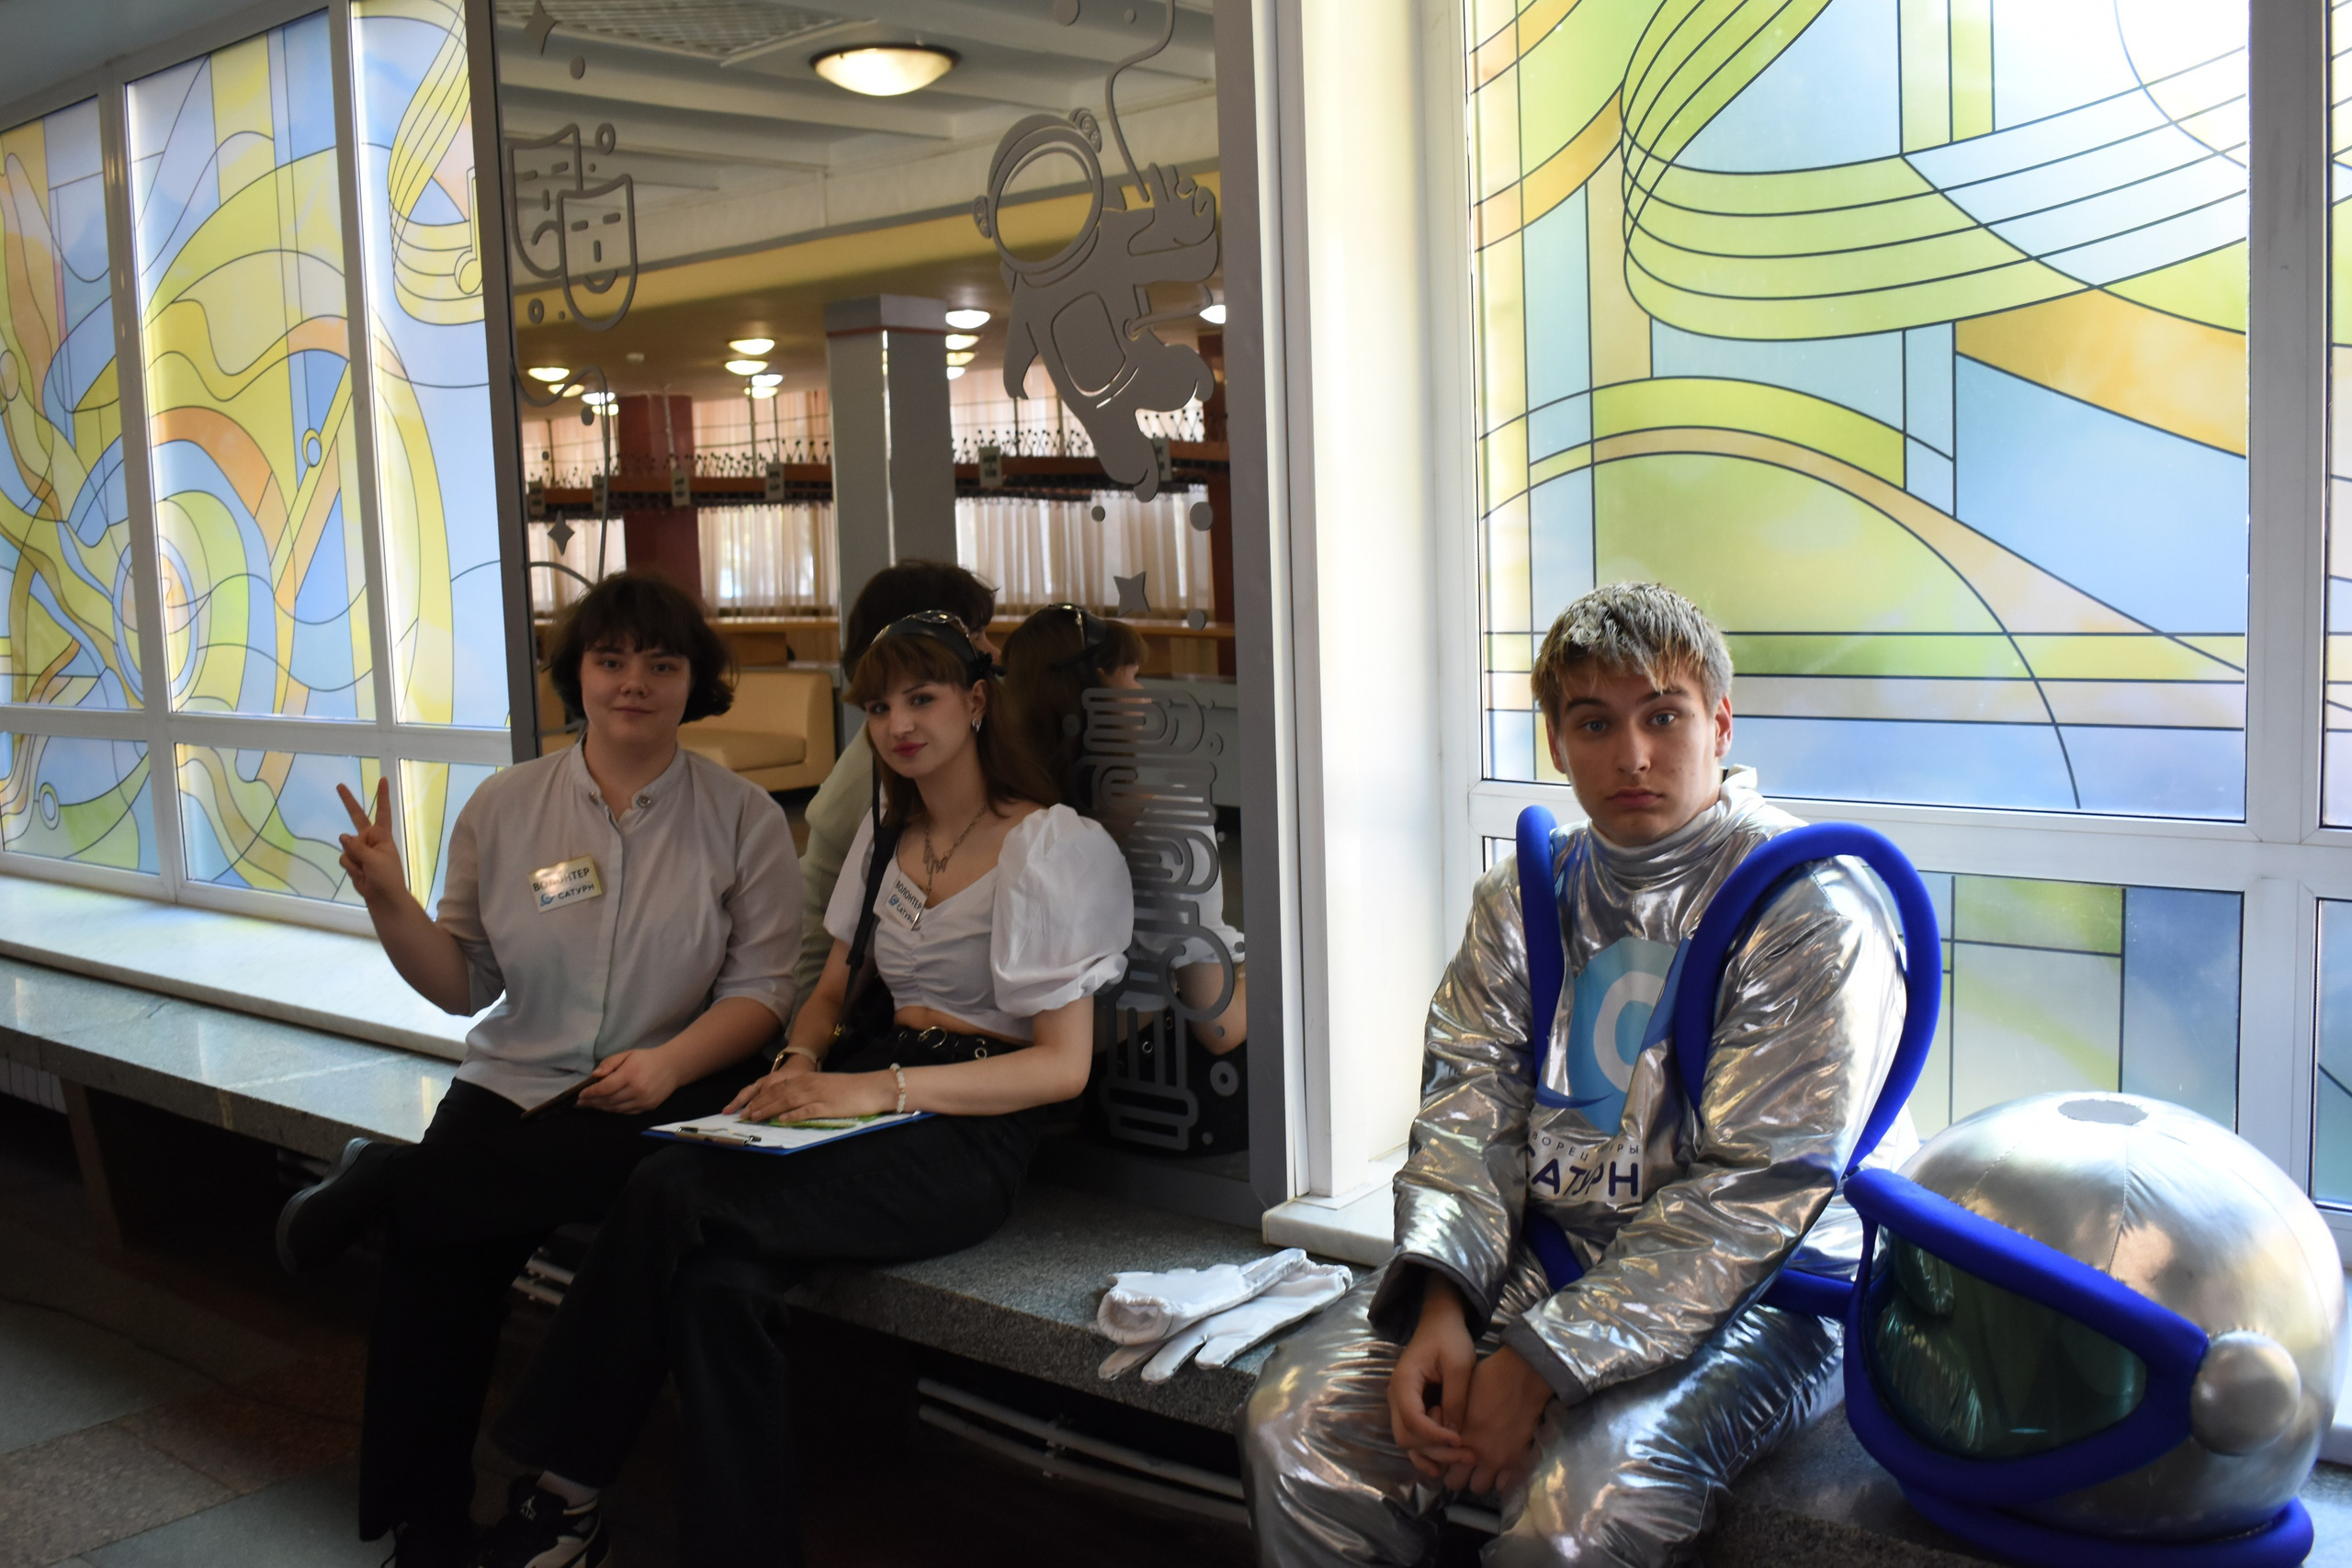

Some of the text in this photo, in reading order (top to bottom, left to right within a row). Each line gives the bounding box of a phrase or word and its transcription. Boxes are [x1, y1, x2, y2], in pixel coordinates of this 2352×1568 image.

[559, 885, 594, 898] САТУРН
[896, 881, 922, 909] ВОЛОНТЕР
[897, 904, 914, 924] САТУРН
[1532, 1131, 1589, 1162] ВОРЕЦ
[1527, 1145, 1638, 1197] АТУРН
